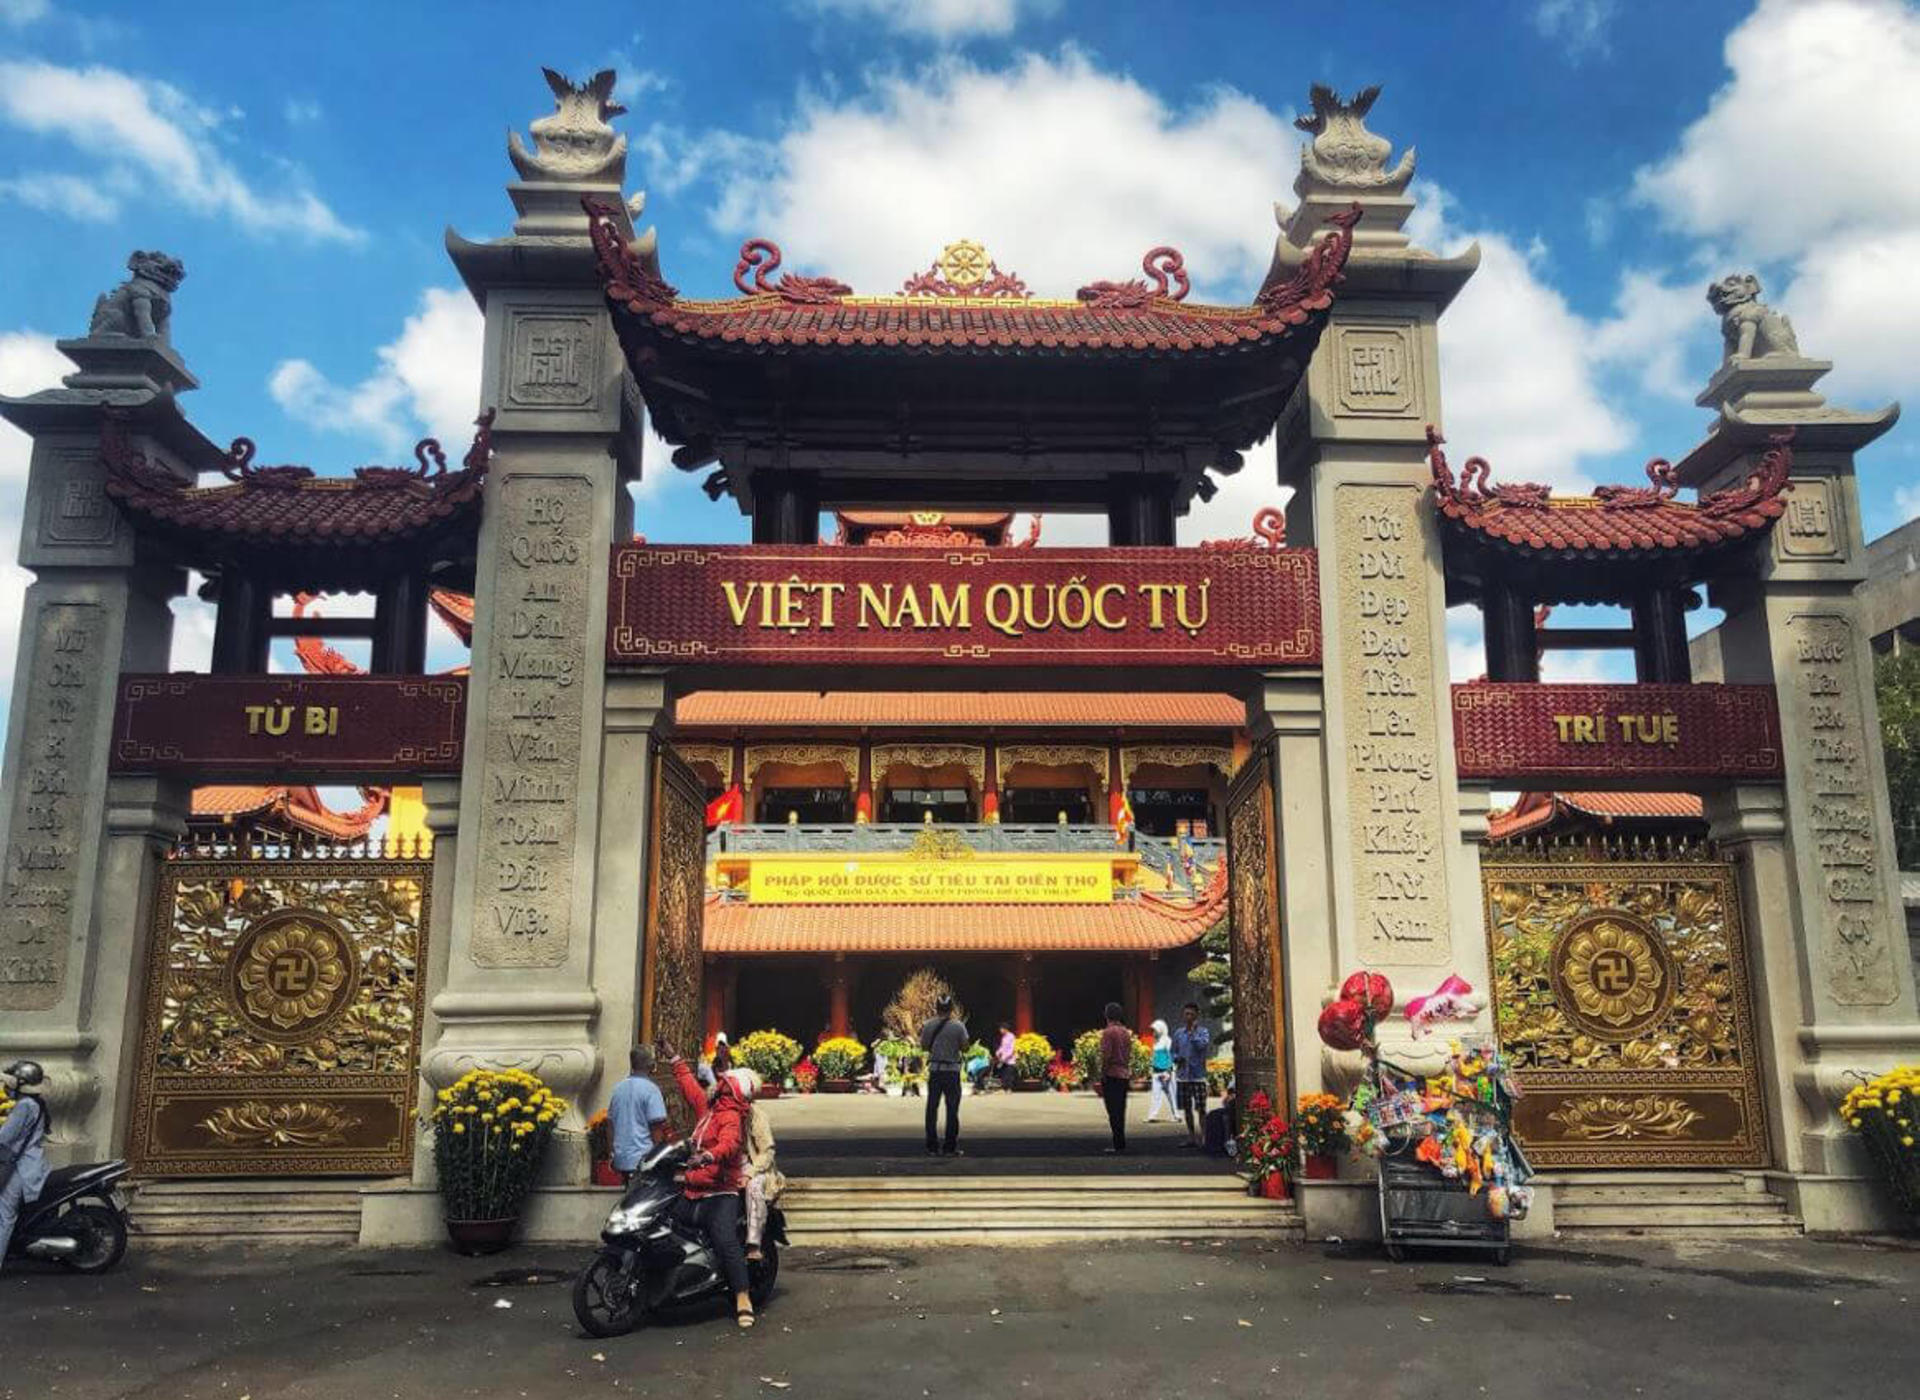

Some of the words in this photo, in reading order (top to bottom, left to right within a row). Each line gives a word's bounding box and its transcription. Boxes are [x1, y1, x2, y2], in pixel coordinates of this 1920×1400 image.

[1358, 507, 1403, 541] Tốt
[510, 528, 581, 568] Quốc
[1359, 550, 1406, 579] Đời
[721, 574, 846, 635] VIỆT
[857, 582, 972, 630] NAM
[984, 576, 1127, 636] QUỐC
[1138, 577, 1213, 639] TỰ
[1359, 590, 1411, 625] Đẹp
[510, 611, 566, 640] Dân
[1360, 628, 1412, 664] Đạo
[245, 698, 296, 735] TỪ
[304, 706, 339, 735] BI
[1364, 706, 1417, 736] Lên
[1553, 708, 1606, 743] TRÍ
[1617, 708, 1679, 749] TUỆ
[506, 732, 560, 763] Văn
[1353, 743, 1434, 781] Phong
[1369, 784, 1422, 813] Phú
[1362, 818, 1434, 863] Khắp
[498, 855, 549, 892] Đất
[764, 873, 813, 887] PHÁP
[818, 872, 850, 887] HỘI
[854, 872, 903, 887] DƯỢC
[908, 873, 932, 886] SƯ
[937, 872, 977, 886] TIÊU
[983, 875, 1011, 886] TAI
[1063, 874, 1099, 888] THỌ
[493, 904, 550, 943] Việt
[1372, 911, 1435, 943] Nam
